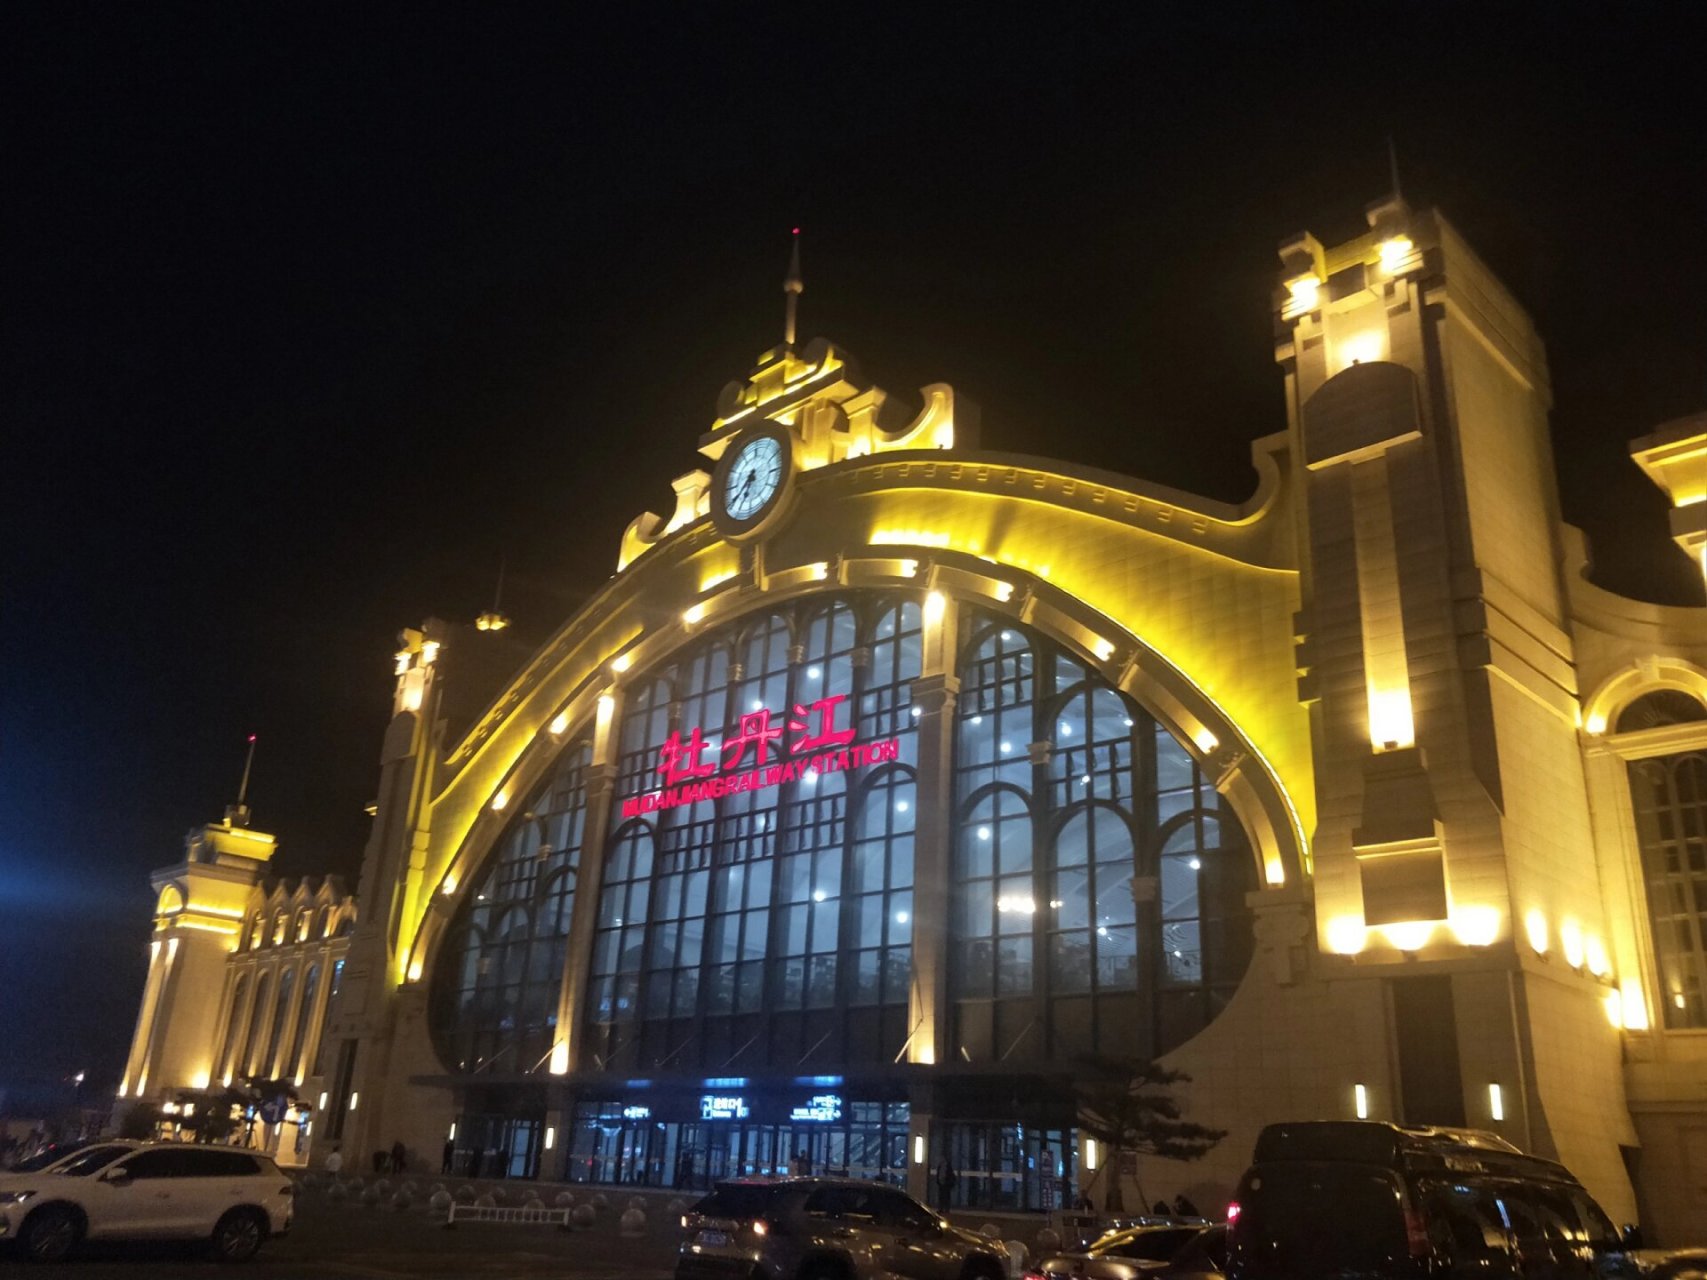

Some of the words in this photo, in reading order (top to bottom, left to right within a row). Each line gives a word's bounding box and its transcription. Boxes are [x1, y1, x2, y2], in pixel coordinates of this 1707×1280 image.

[657, 694, 856, 787] 牡丹江
[810, 736, 900, 774] STATION
